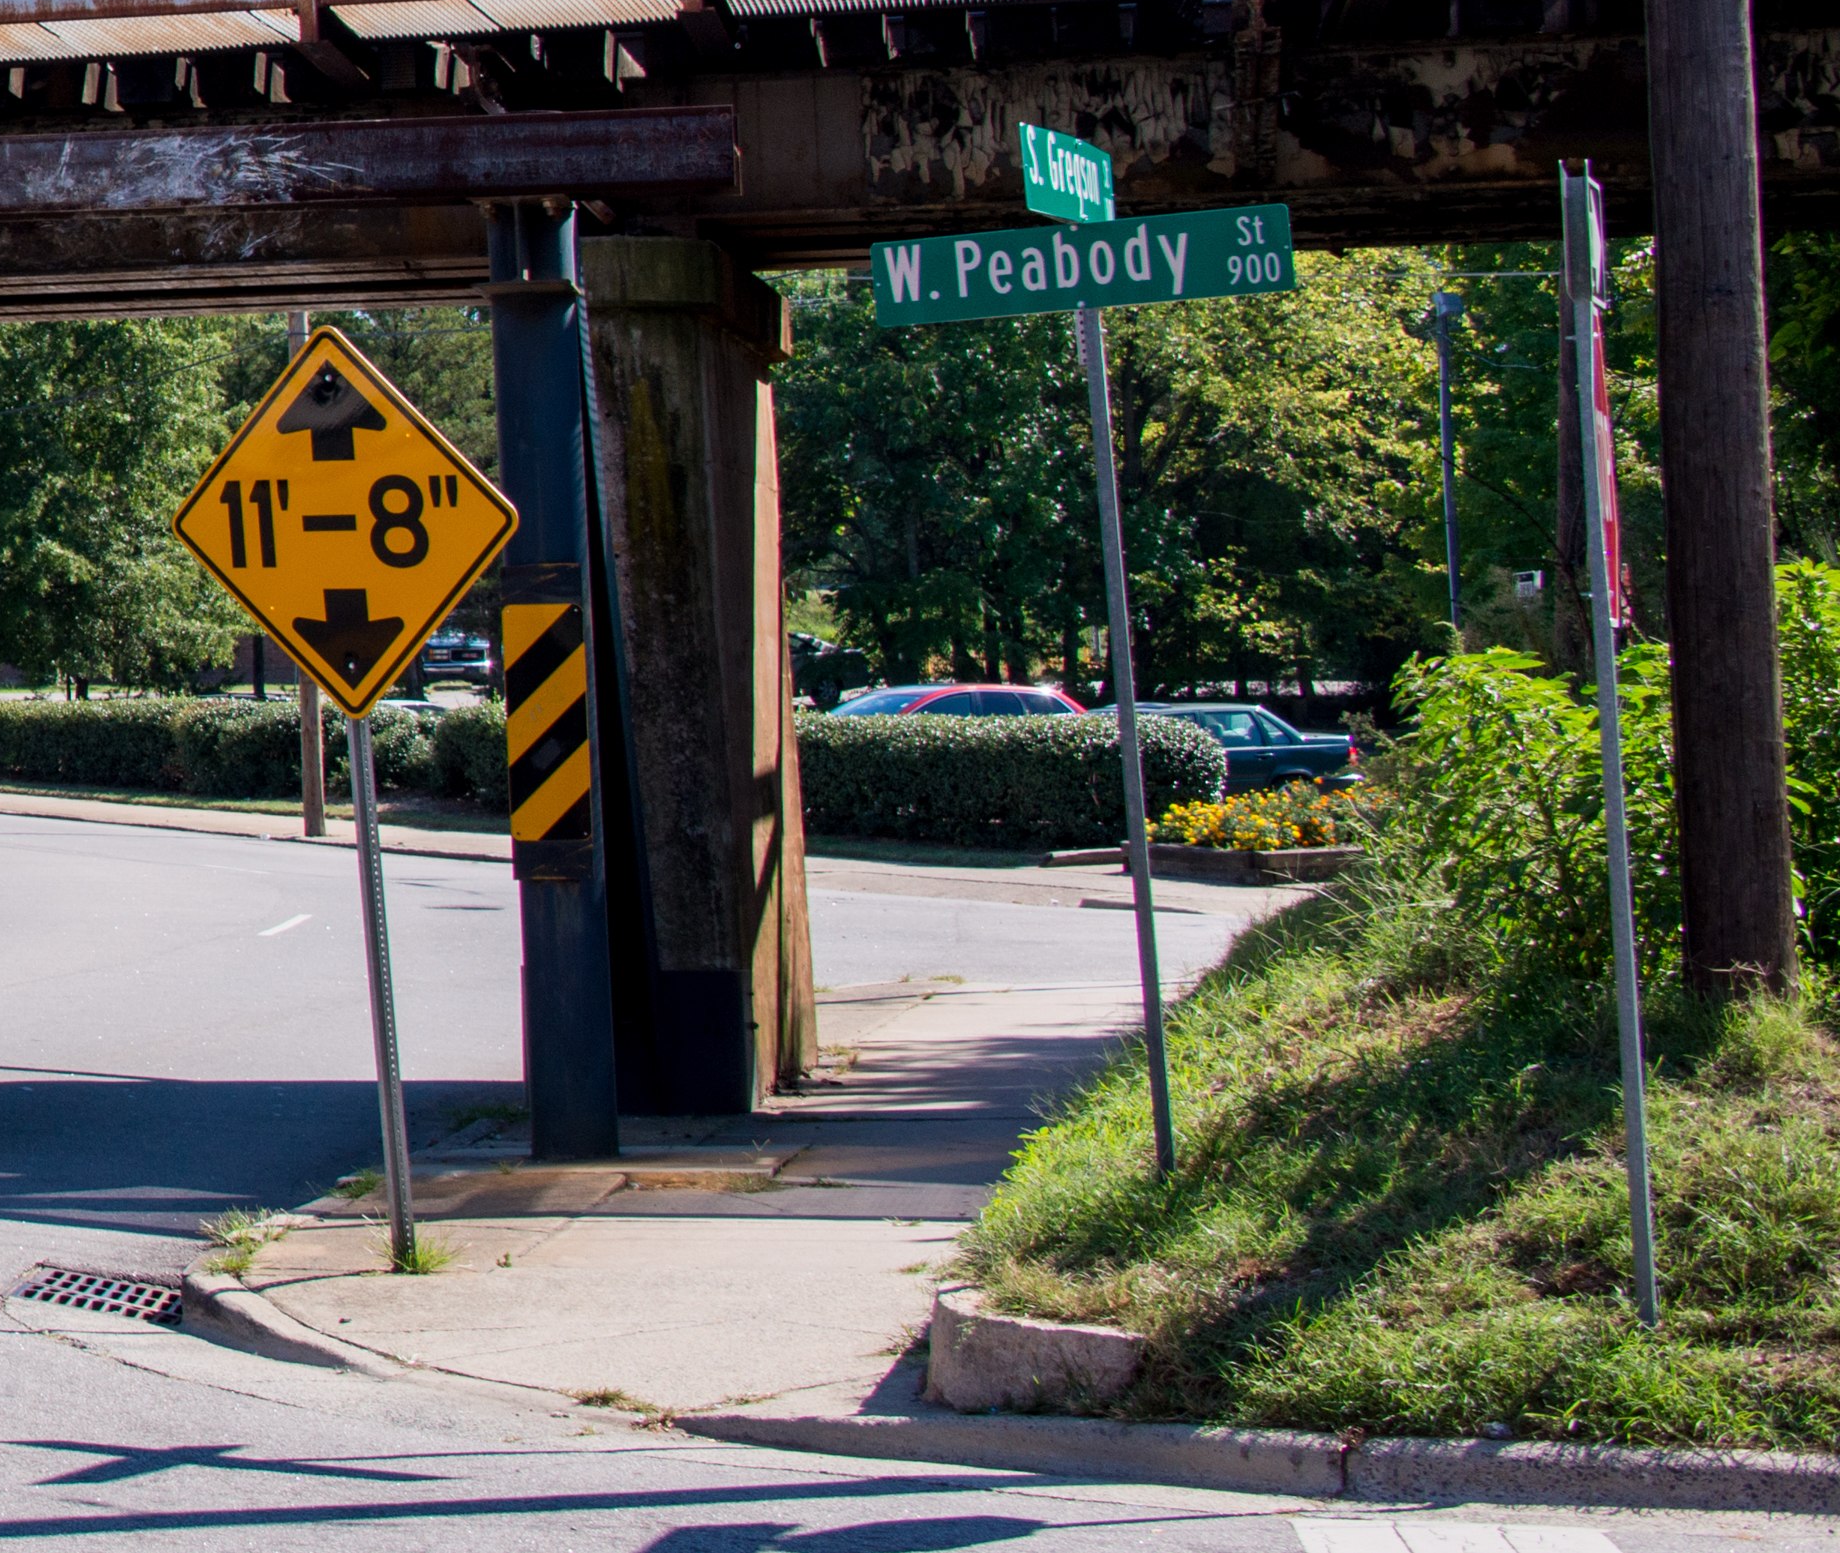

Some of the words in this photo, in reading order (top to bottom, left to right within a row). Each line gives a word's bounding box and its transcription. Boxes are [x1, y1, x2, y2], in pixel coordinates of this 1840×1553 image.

[1026, 125, 1045, 186] S.
[1047, 131, 1101, 221] Gregson
[883, 244, 941, 304] W.
[954, 223, 1188, 298] Peabody
[1236, 215, 1265, 246] St
[1227, 252, 1282, 286] 900
